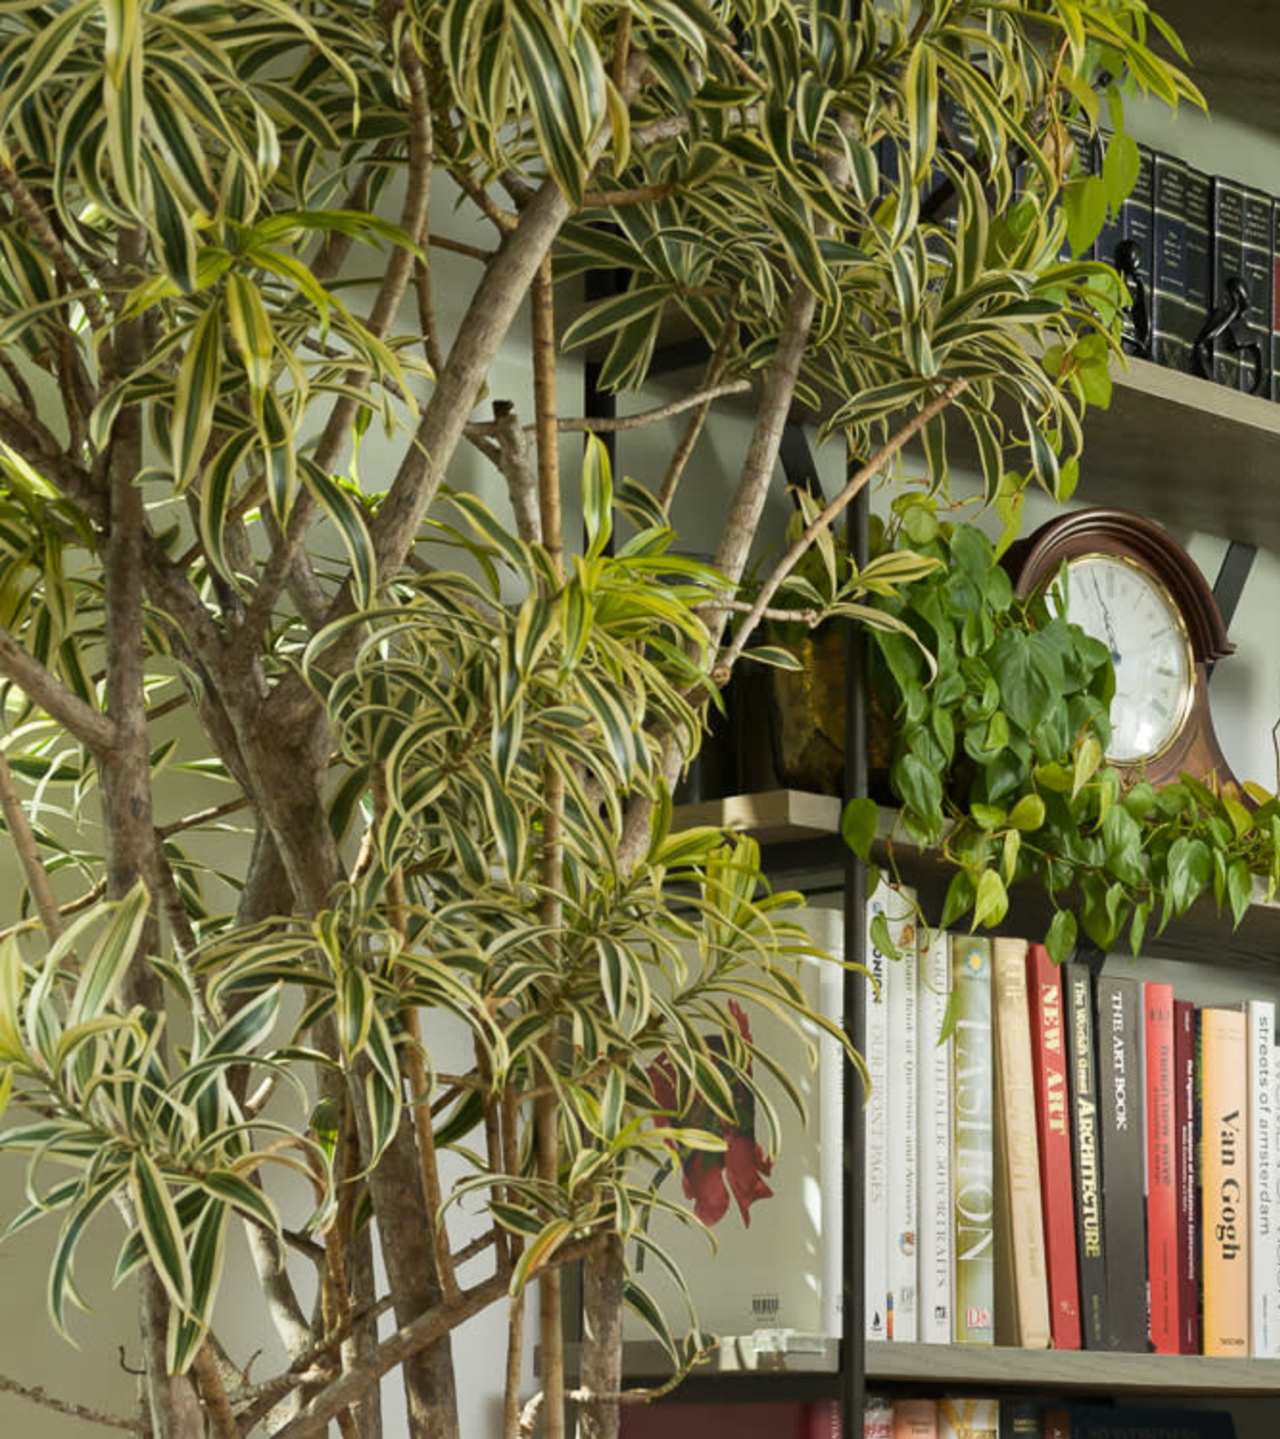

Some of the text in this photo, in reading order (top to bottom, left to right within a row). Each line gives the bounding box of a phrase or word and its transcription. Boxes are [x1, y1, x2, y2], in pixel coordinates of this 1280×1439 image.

[1040, 983, 1067, 1136] NEW ART
[1111, 992, 1128, 1131] THE ART BOOK
[1258, 1016, 1272, 1237] streets of amsterdam
[871, 1145, 884, 1203] PAGES
[954, 1019, 993, 1262] FASHION
[1078, 1097, 1101, 1260] ARCHITECTURE
[1215, 1110, 1242, 1261] Van Gogh
